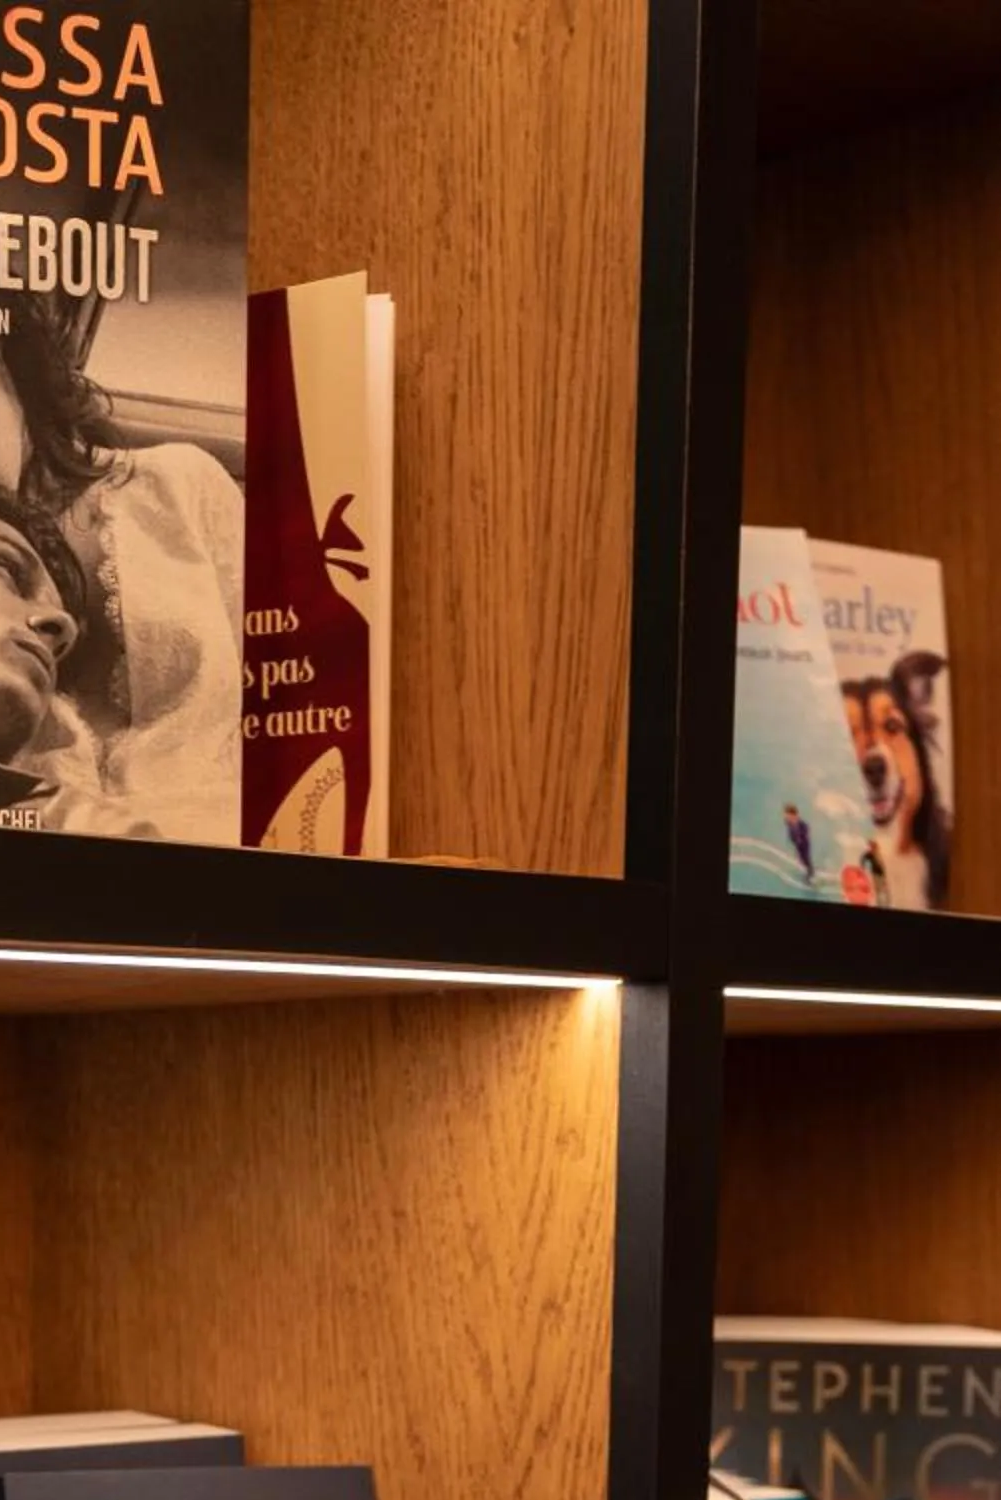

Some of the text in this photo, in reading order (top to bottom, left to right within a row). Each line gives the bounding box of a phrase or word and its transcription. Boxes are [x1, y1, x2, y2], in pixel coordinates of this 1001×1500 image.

[261, 655, 315, 700] pas
[266, 702, 352, 737] autre
[722, 1359, 1001, 1419] TEPHEN
